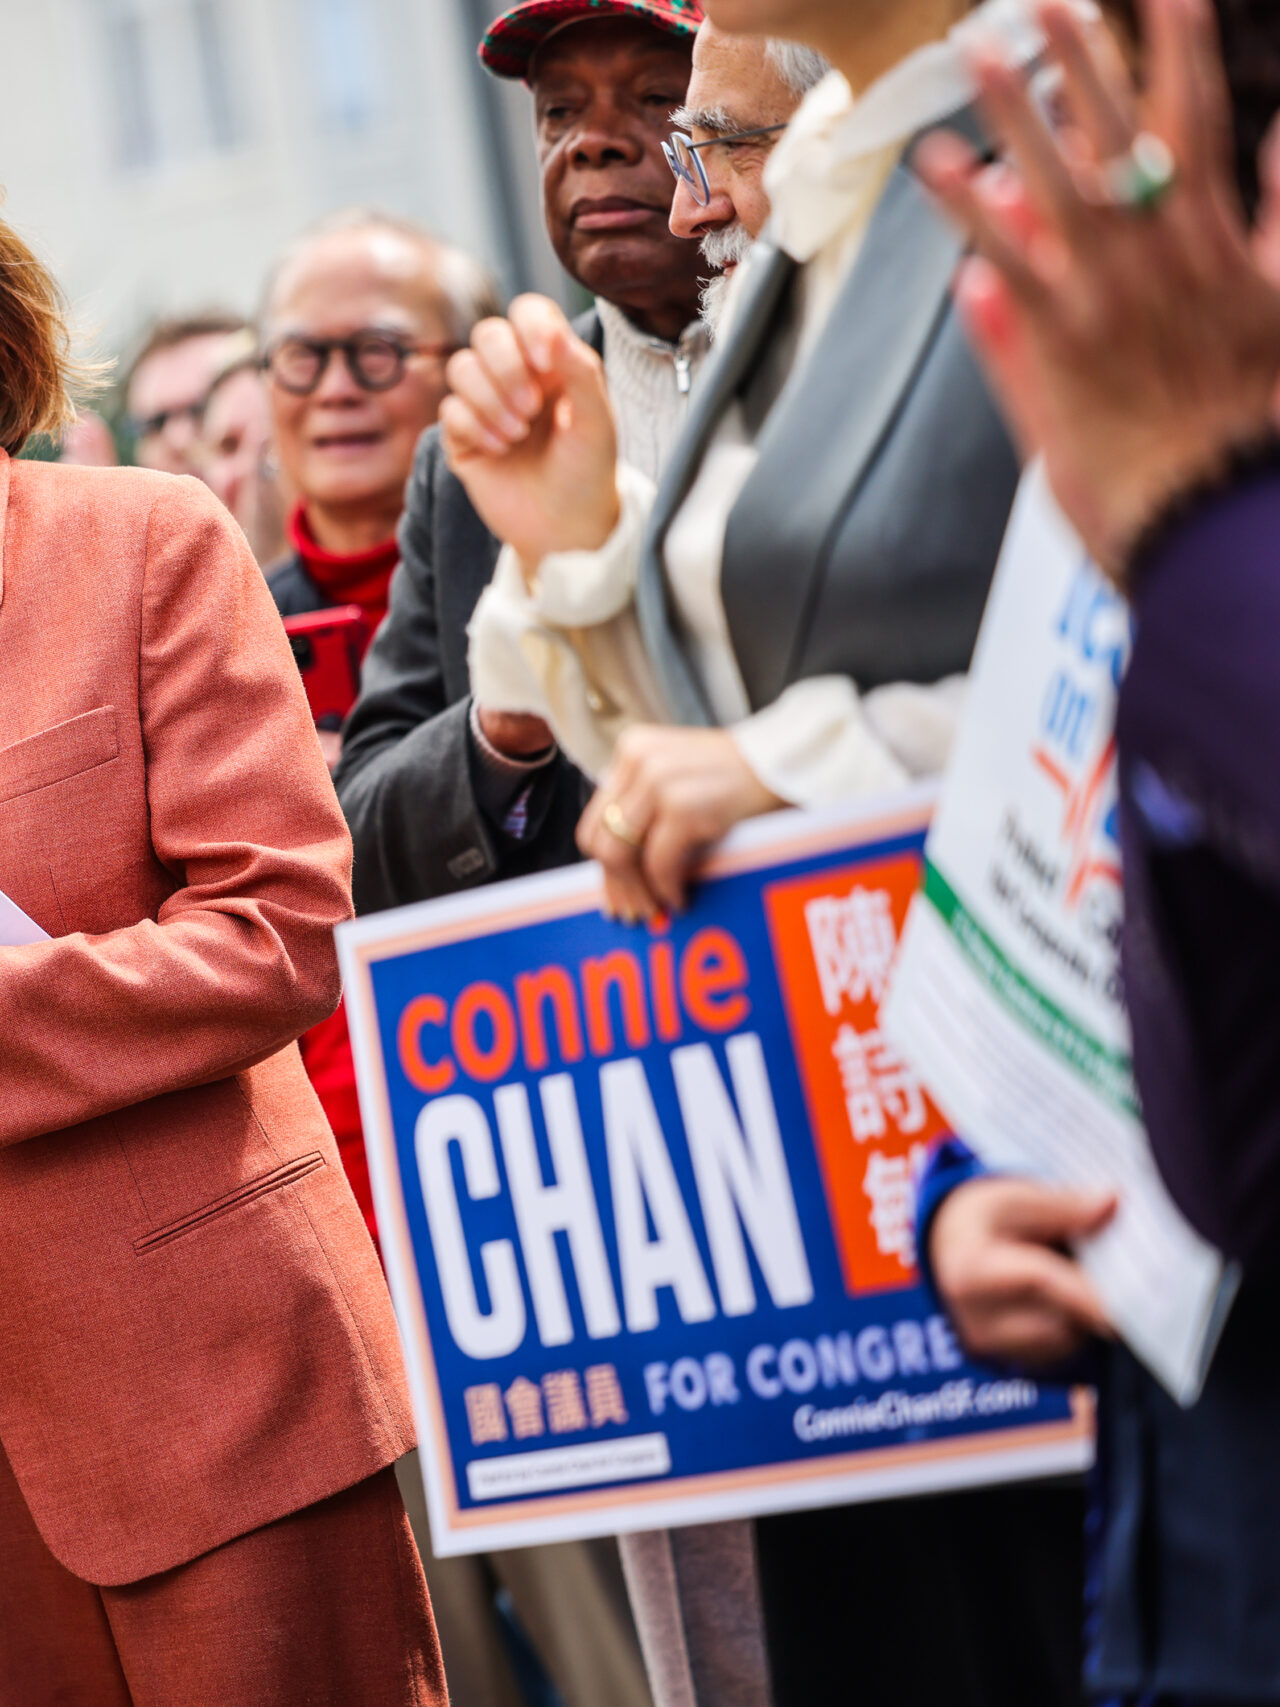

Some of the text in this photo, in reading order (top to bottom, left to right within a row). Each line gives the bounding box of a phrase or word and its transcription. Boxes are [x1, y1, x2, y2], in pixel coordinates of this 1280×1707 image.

[397, 912, 752, 1093] connie
[414, 1031, 814, 1360] CHAN
[643, 1313, 965, 1416] FOR CONGRE
